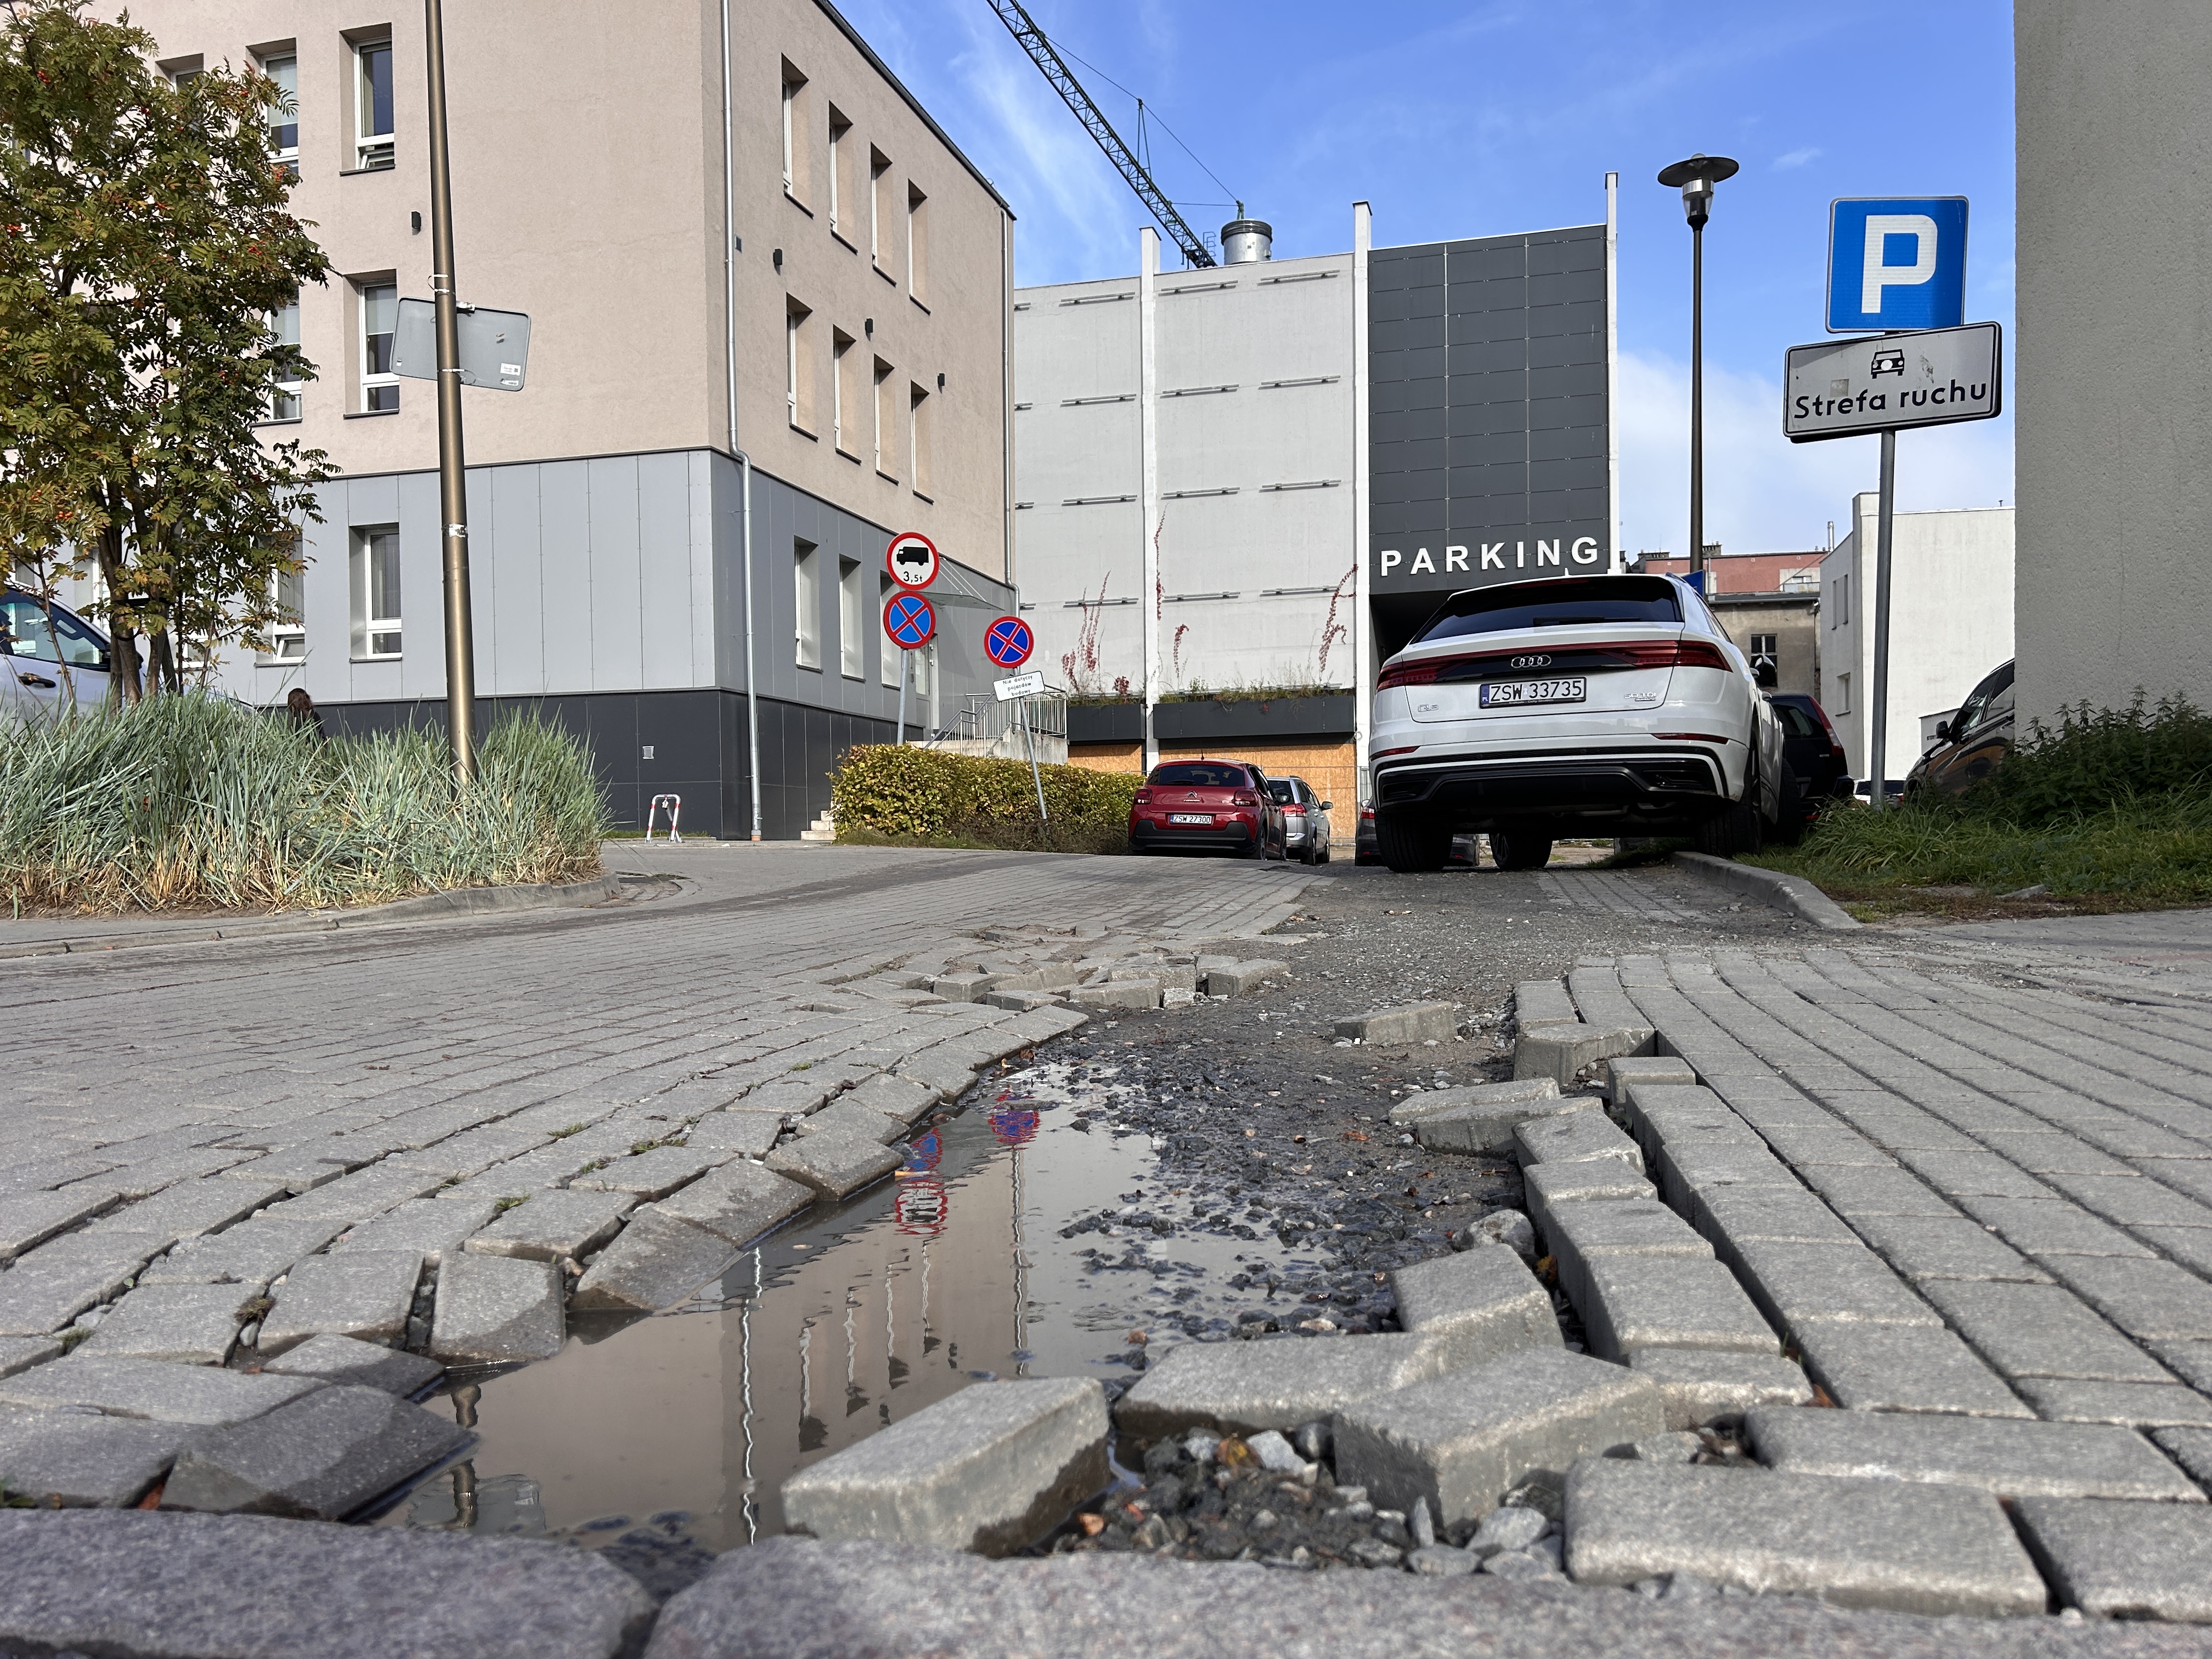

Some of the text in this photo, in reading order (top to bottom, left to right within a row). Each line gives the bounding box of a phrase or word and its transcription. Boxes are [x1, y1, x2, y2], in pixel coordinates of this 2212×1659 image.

[1861, 215, 1938, 313] P
[1794, 379, 1986, 419] Strefa ruchu
[1380, 537, 1598, 577] PARKING
[904, 571, 922, 583] 3,5t
[1008, 682, 1031, 691] pojazdów
[1491, 680, 1582, 702] ZSW 33735
